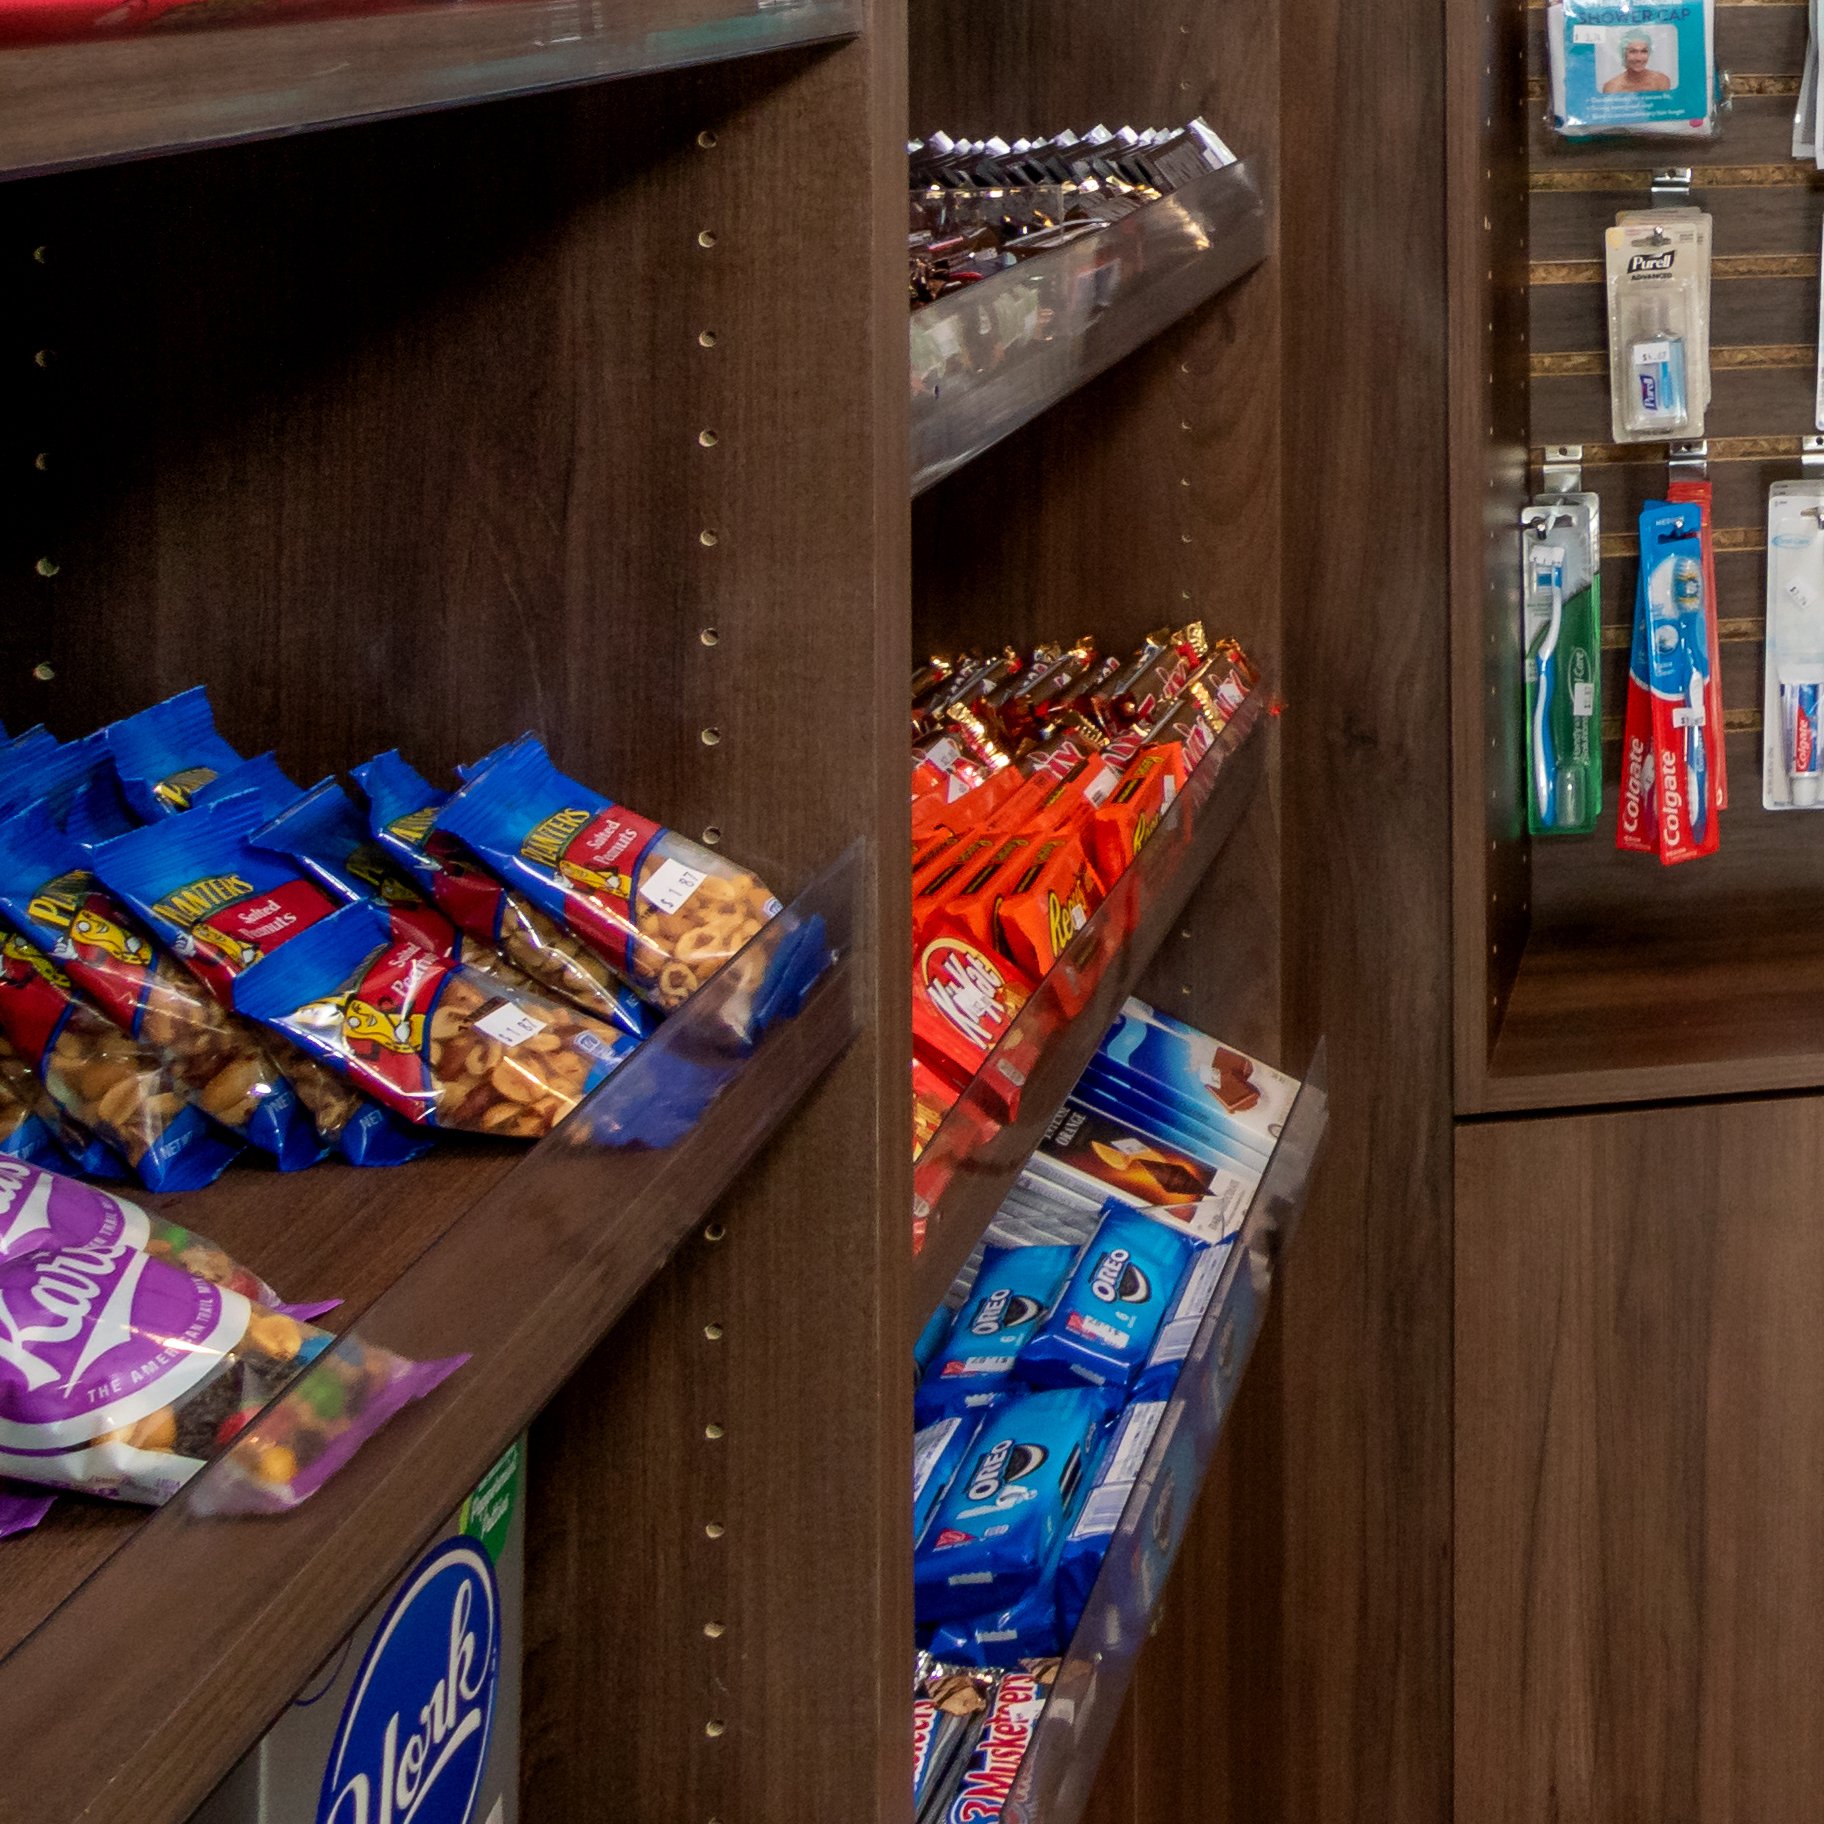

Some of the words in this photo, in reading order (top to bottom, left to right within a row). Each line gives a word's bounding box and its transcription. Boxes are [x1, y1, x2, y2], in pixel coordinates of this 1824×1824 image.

[1576, 9, 1652, 26] SHOWER
[1656, 7, 1691, 23] CAP
[1631, 254, 1673, 271] Purell
[1641, 375, 1657, 411] Purell
[1622, 735, 1646, 833] Colgate
[1662, 749, 1679, 848] Colgate
[520, 807, 591, 866] PLANTERS
[590, 819, 621, 852] Salted
[237, 898, 283, 926] Salted
[1055, 1112, 1086, 1148] ORANGE
[1092, 1247, 1130, 1304] OREO
[970, 1288, 1012, 1336] OREO
[87, 1377, 123, 1403] THE
[194, 1298, 215, 1331] TRAIL
[966, 1438, 1015, 1501] OREO
